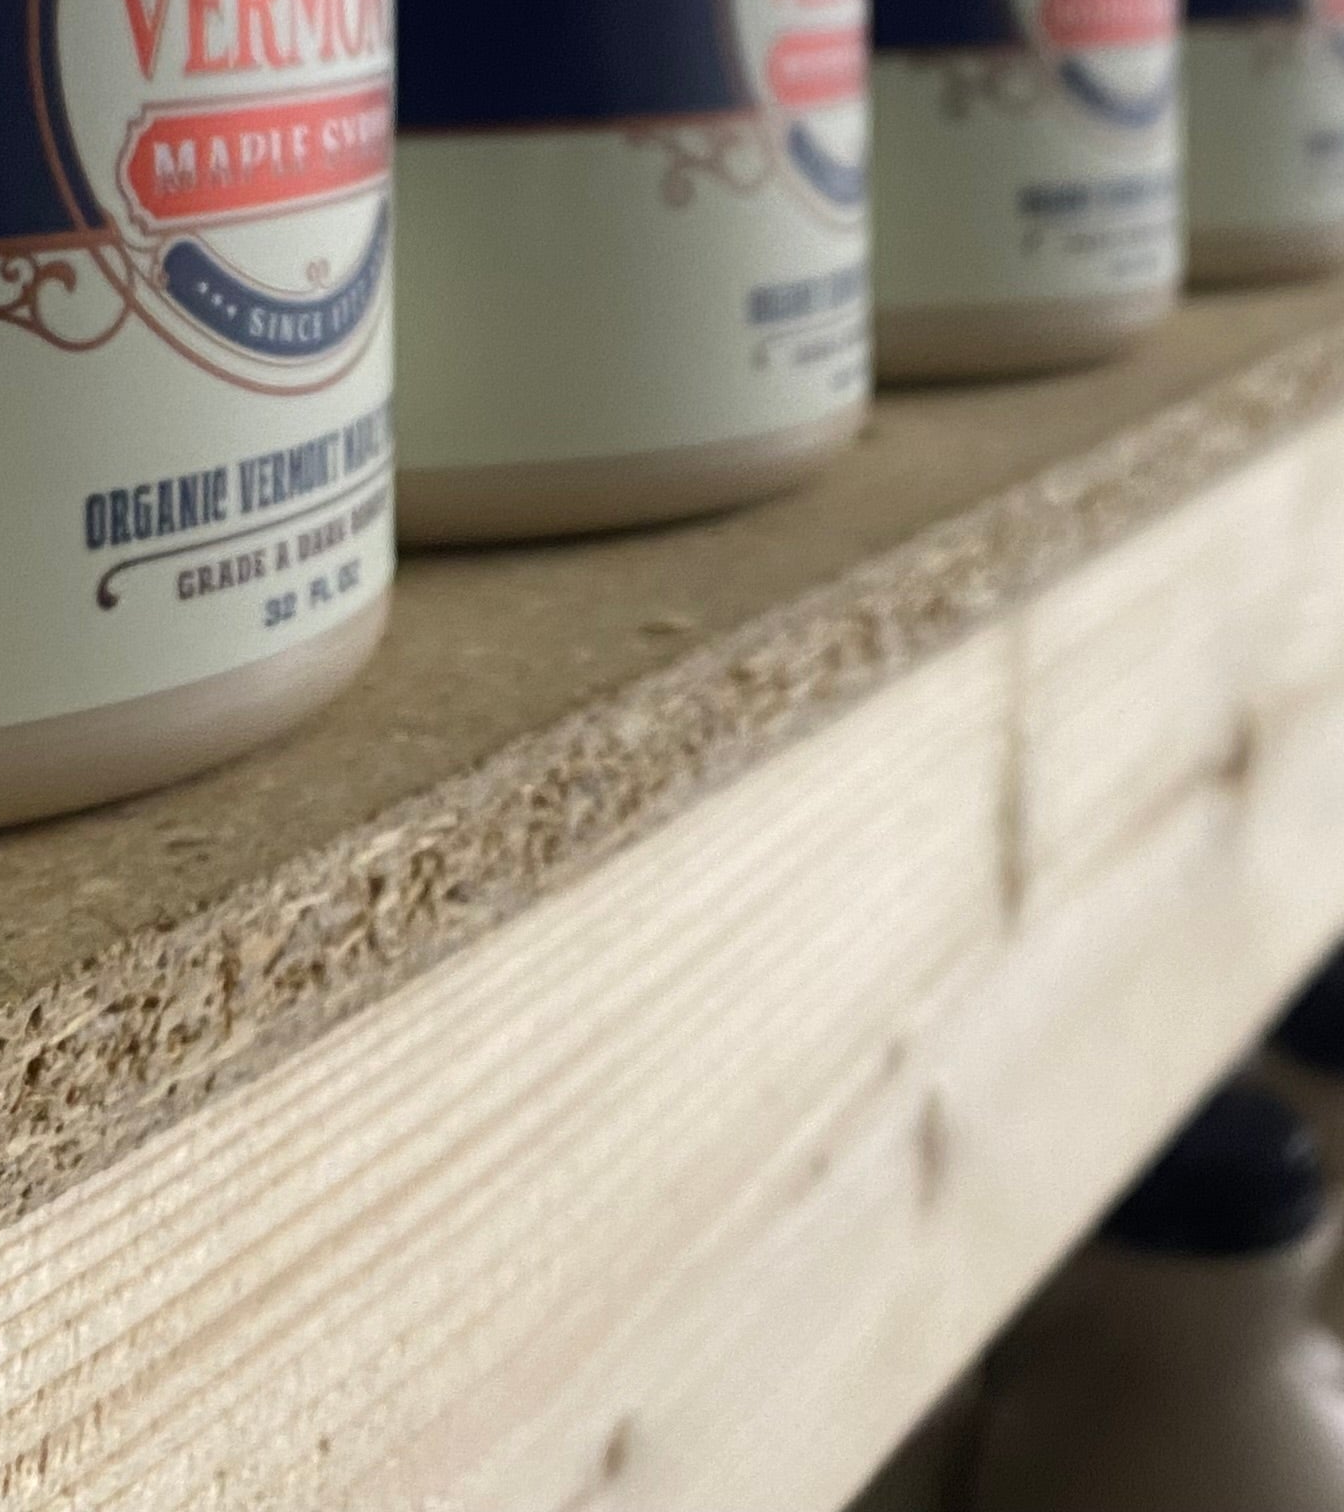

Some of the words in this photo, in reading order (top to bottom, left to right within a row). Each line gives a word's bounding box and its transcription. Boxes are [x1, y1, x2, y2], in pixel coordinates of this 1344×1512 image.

[153, 122, 310, 196] MAPLE
[85, 464, 228, 550] ORGANIC
[238, 430, 341, 514] VERMONT
[177, 547, 268, 602] GRADE
[275, 540, 291, 572] A
[264, 591, 297, 628] 32
